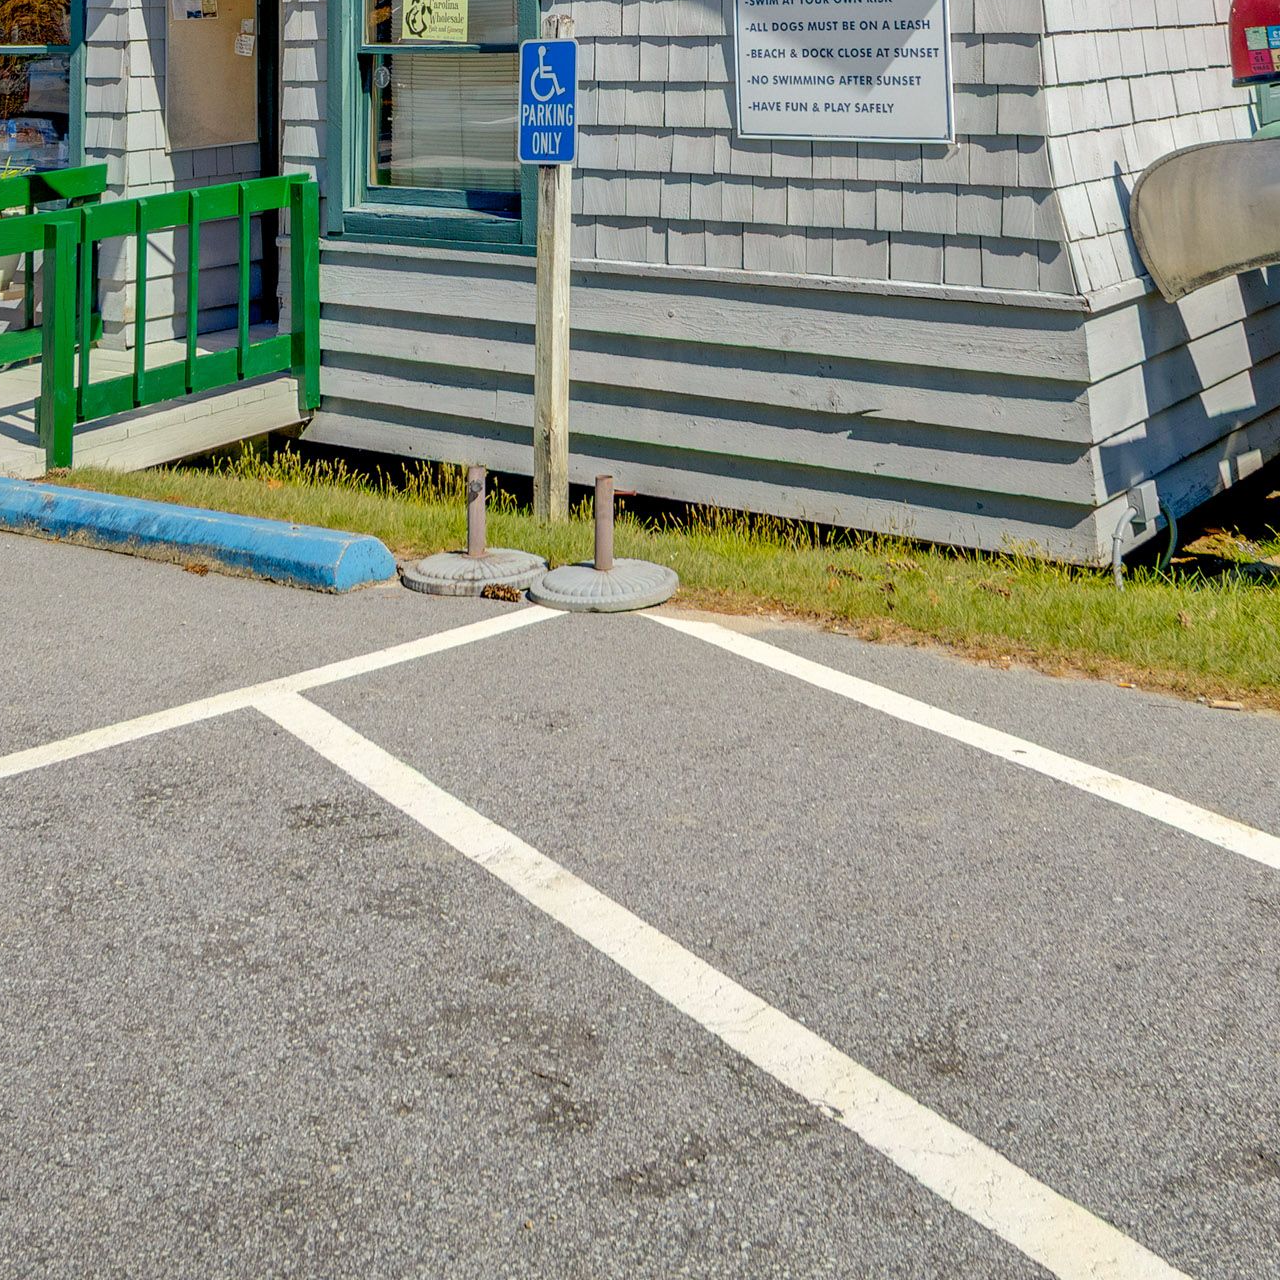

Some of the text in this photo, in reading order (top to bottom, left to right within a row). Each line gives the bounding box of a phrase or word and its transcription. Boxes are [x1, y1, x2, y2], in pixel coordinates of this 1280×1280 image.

[430, 12, 464, 24] Wholesale
[745, 20, 931, 32] -ALL DOGS MUST BE ON A LEASH
[746, 47, 939, 59] -BEACH & DOCK CLOSE AT SUNSET
[747, 75, 921, 86] -NO SWIMMING AFTER SUNSET
[748, 102, 894, 114] -HAVE FUN & PLAY SAFELY
[522, 103, 573, 127] PARKING
[532, 131, 562, 155] ONLY
